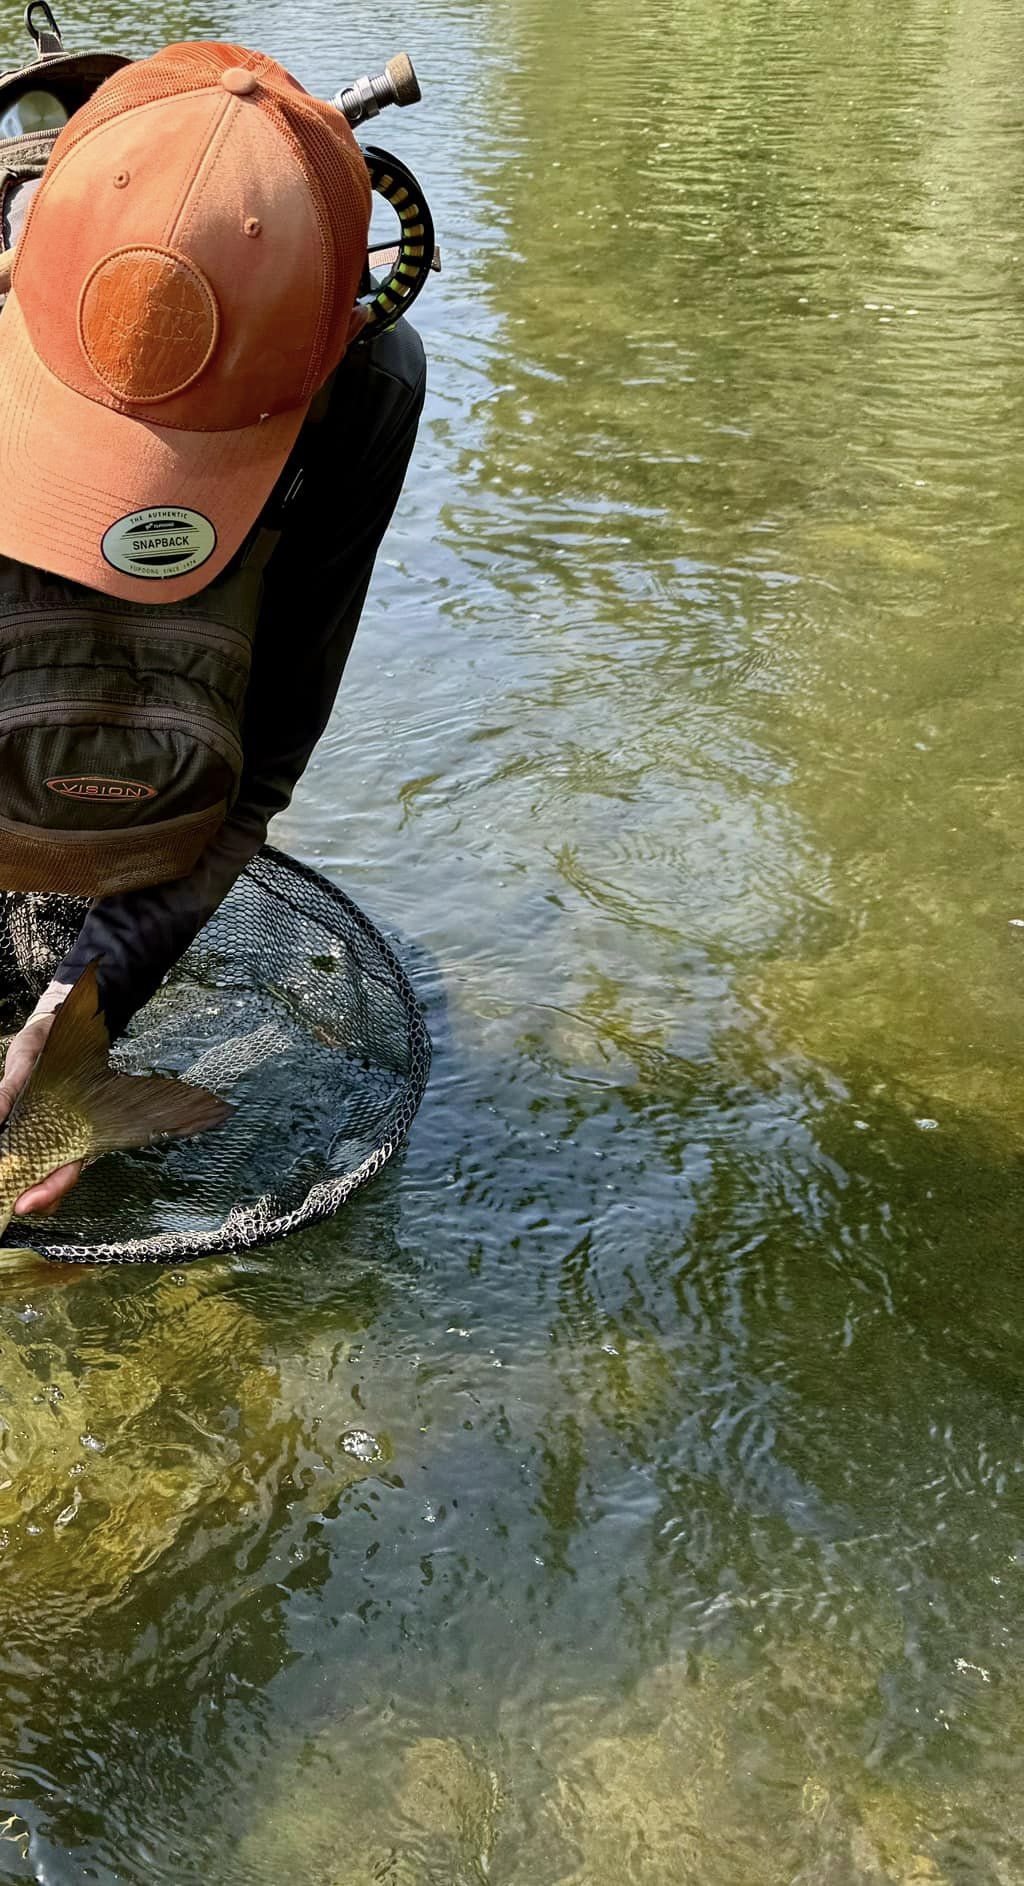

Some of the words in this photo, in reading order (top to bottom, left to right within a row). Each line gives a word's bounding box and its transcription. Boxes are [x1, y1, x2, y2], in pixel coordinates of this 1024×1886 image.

[130, 515, 143, 524] THE
[148, 511, 188, 519] AUTHENTIC
[132, 535, 190, 550] SNAPBACK
[62, 782, 141, 797] VISION
